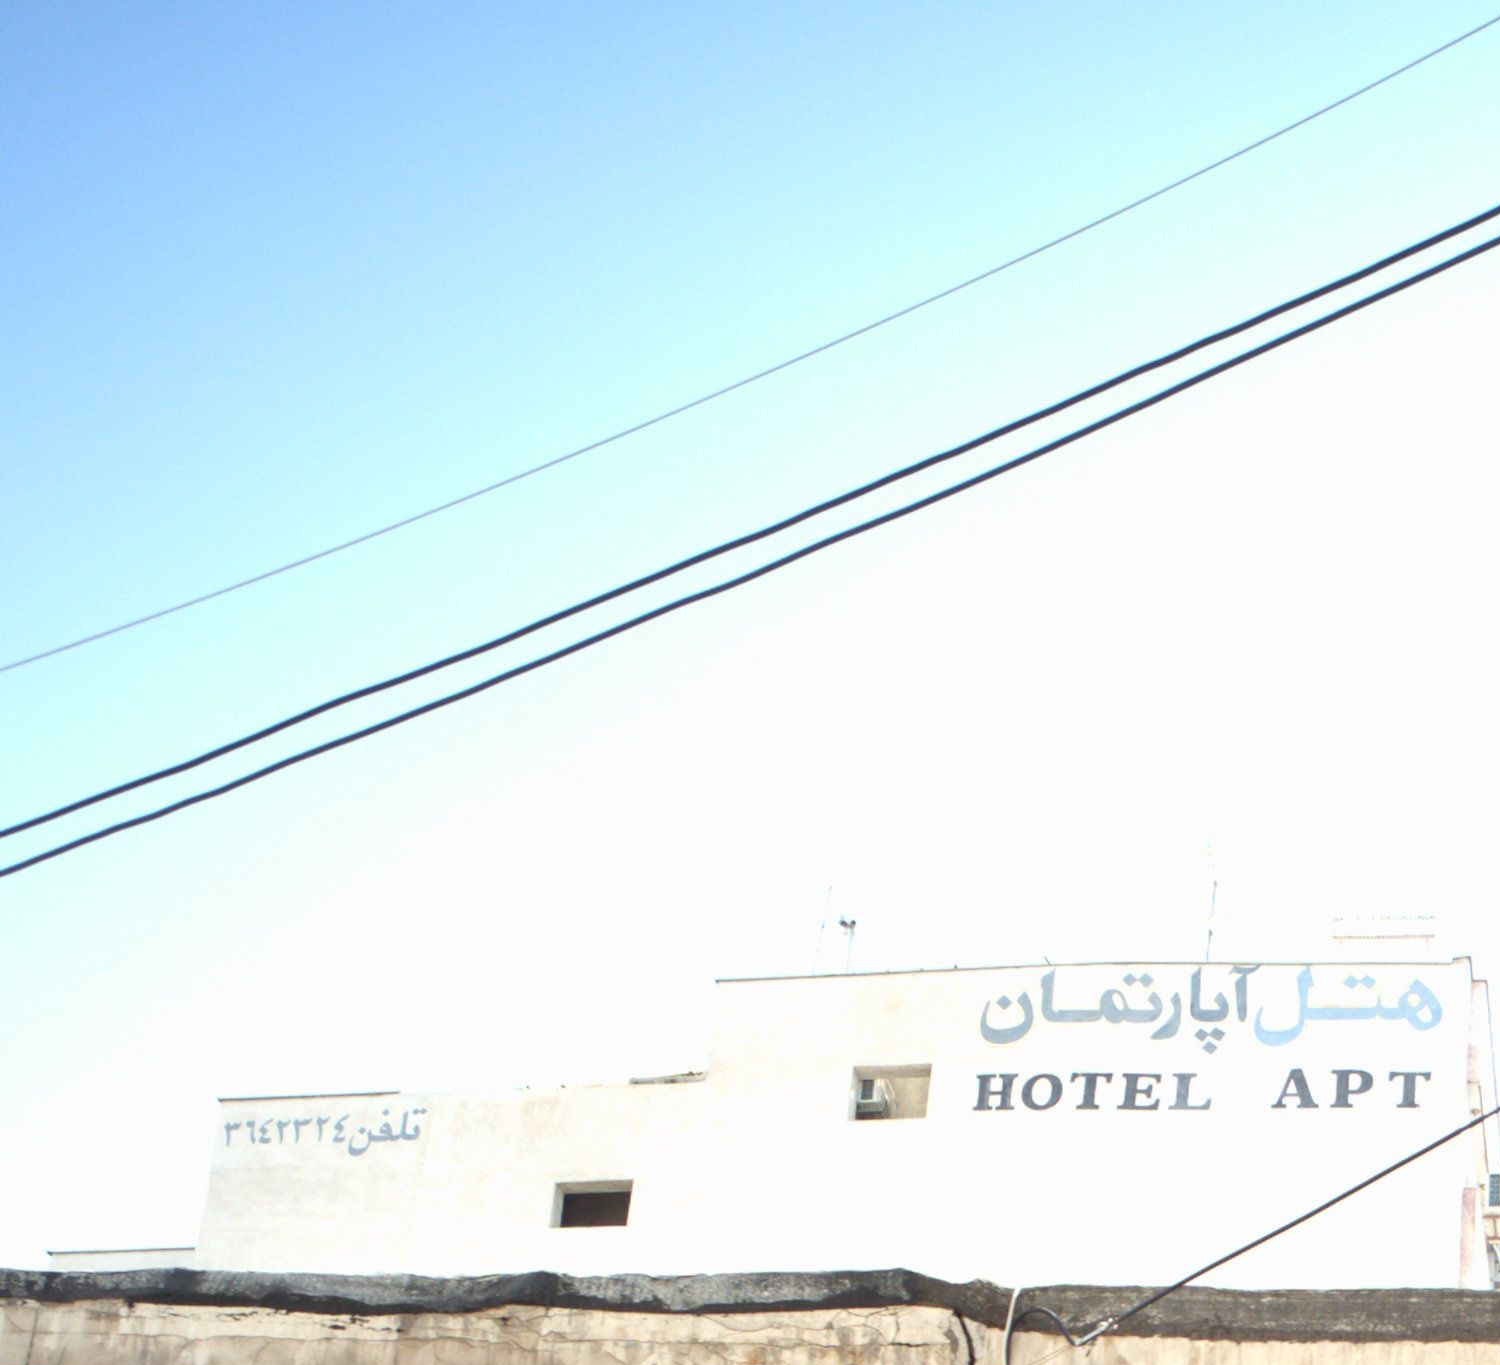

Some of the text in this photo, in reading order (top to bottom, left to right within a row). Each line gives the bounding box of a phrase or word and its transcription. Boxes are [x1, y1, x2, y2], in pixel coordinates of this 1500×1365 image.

[980, 965, 1443, 1054] هتل آپارتمان
[973, 1068, 1432, 1111] HOTEL APT
[348, 1107, 427, 1156] تلفن
